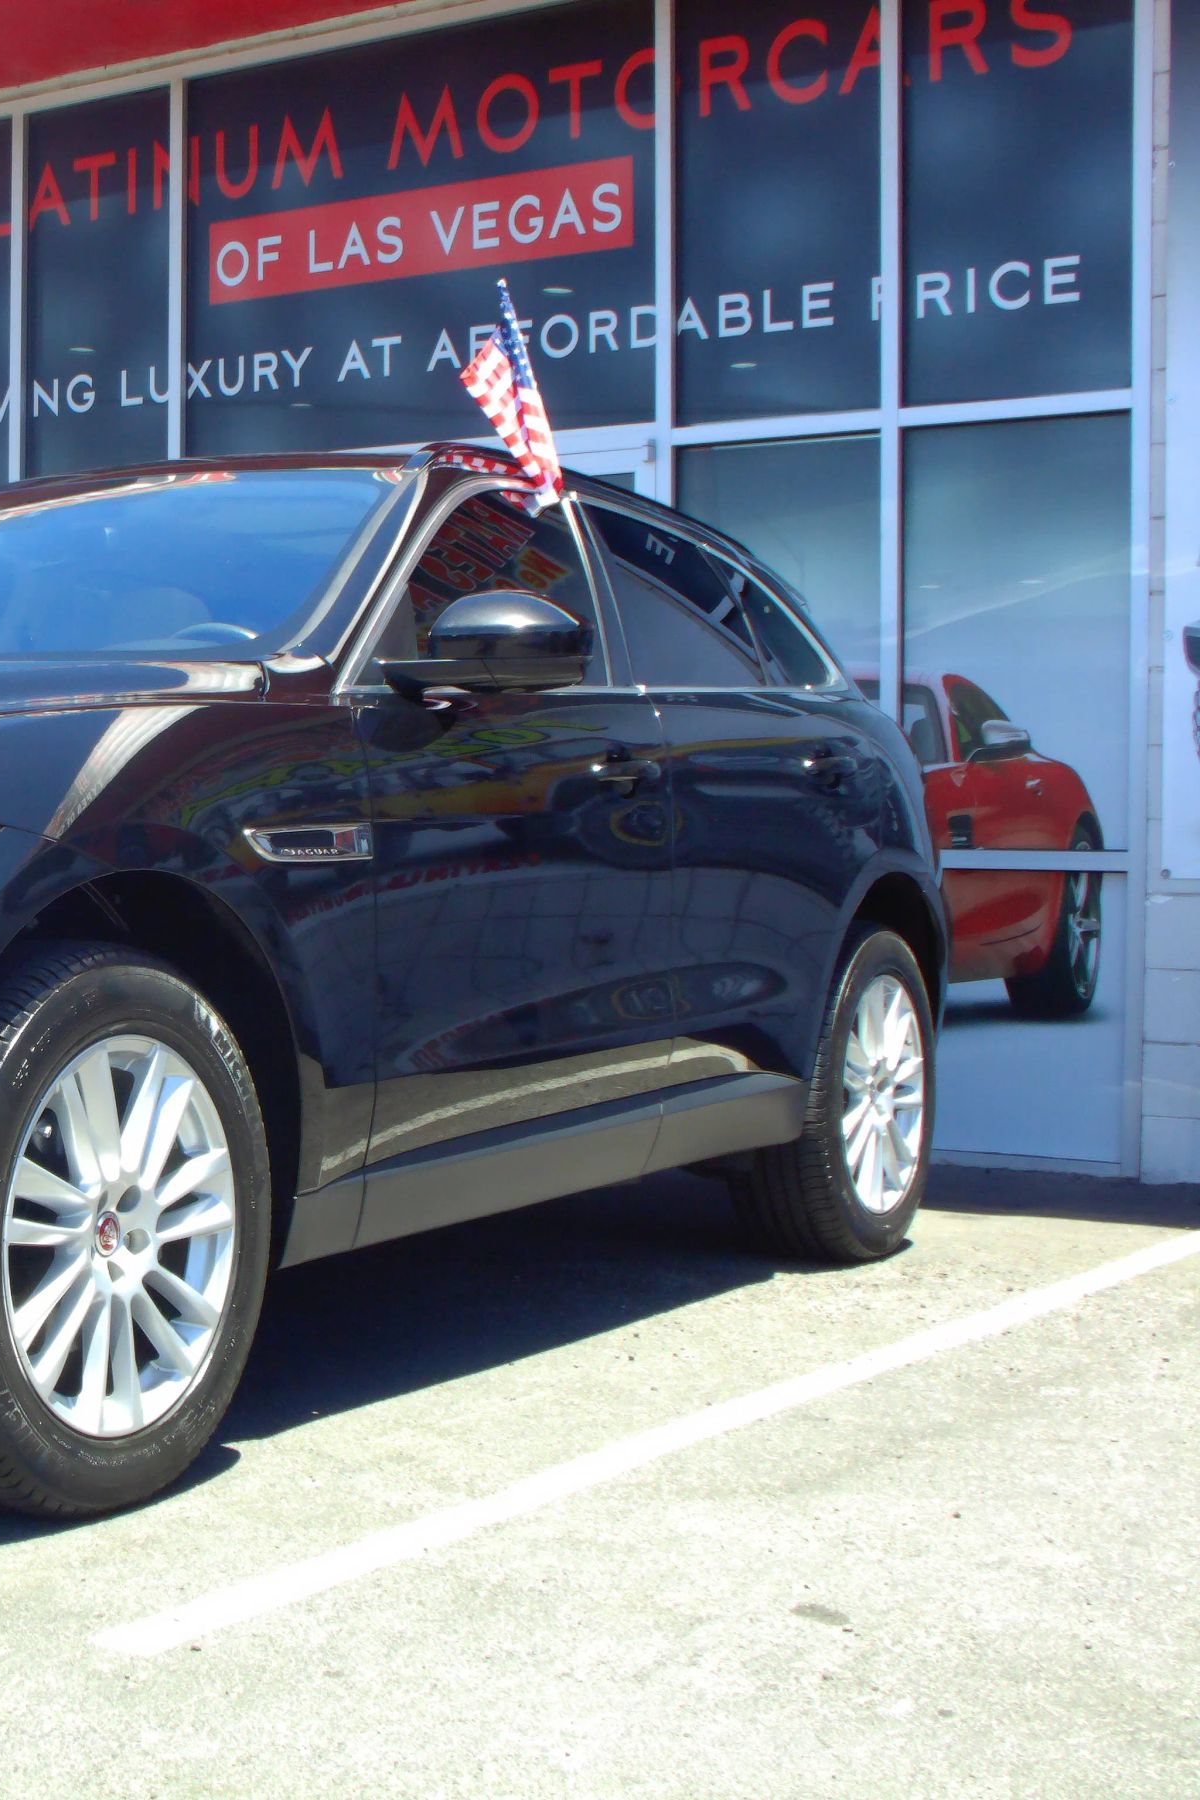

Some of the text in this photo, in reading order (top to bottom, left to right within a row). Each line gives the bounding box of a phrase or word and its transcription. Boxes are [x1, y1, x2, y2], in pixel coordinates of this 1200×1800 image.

[386, 0, 1074, 170] MOTORCARS
[216, 182, 623, 288] OF LAS VEGAS
[120, 346, 314, 407] LUXURY
[337, 335, 402, 383] AT
